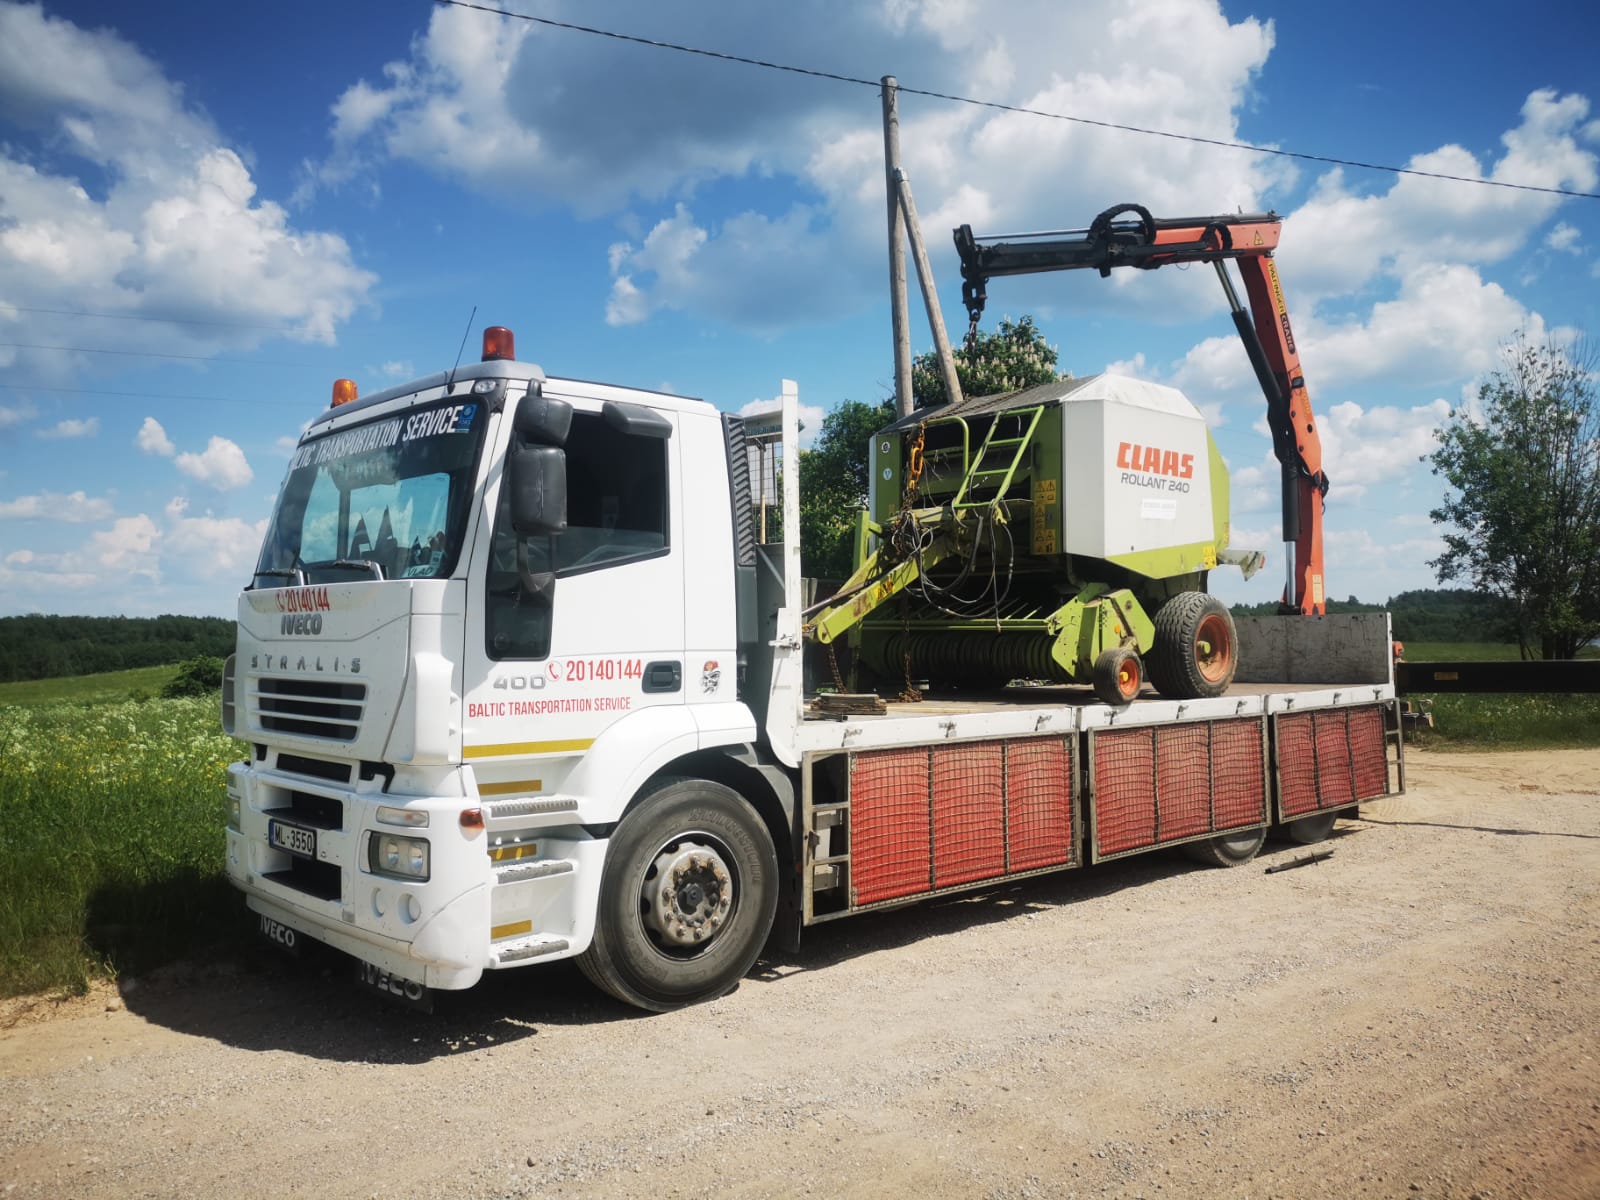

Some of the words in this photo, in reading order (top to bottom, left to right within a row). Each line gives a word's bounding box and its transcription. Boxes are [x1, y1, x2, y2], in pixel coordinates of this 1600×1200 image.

[402, 405, 465, 442] SERVICE
[1116, 441, 1194, 479] CLAAS
[1121, 472, 1167, 490] ROLLANT
[1168, 480, 1190, 494] 240
[285, 586, 331, 613] 20140144
[281, 613, 323, 636] IVECO
[251, 654, 361, 674] STRALIS
[493, 675, 547, 691] 400
[566, 659, 642, 681] 20140144
[468, 702, 506, 718] BALTIC
[508, 698, 592, 716] TRANSPORTATION
[594, 696, 631, 712] SERVICE
[274, 824, 313, 852] ML-3550
[260, 913, 296, 948] IVECO
